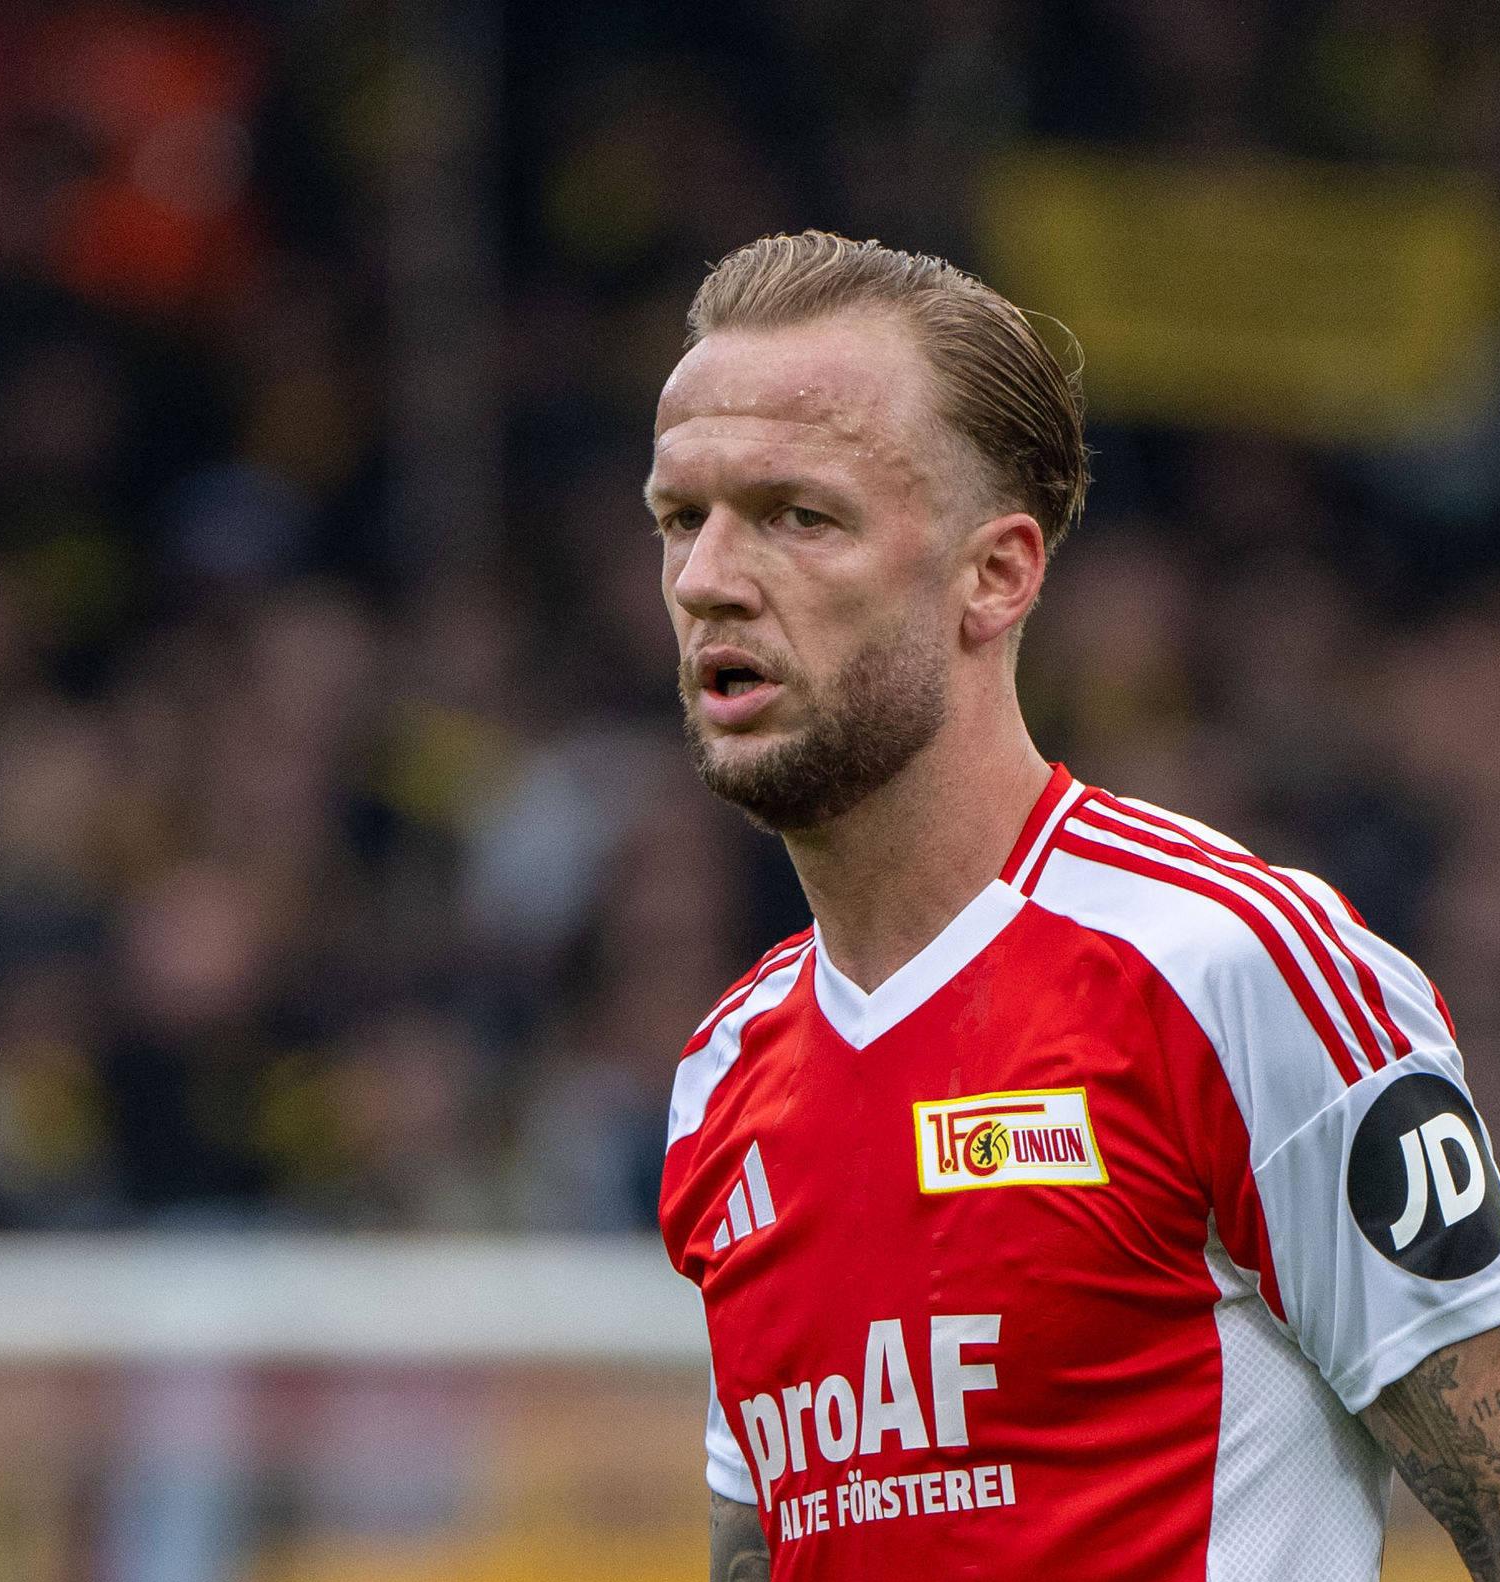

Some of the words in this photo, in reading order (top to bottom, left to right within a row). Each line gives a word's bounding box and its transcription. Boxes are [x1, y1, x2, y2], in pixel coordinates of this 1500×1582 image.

[1012, 1127, 1087, 1163] UNION
[1389, 1112, 1486, 1251] JD
[739, 1314, 1002, 1512] proAF
[780, 1489, 830, 1543] ALTE
[836, 1463, 1016, 1527] FÖRSTEREI
